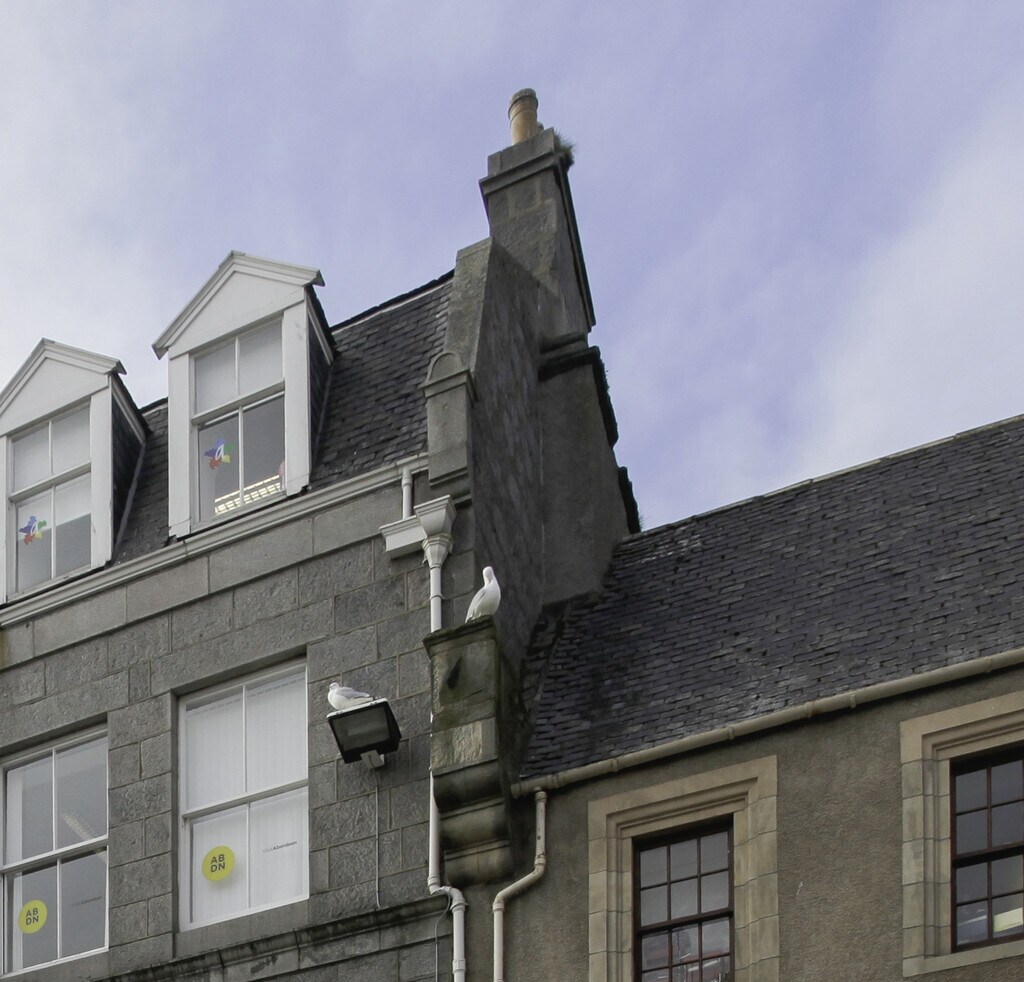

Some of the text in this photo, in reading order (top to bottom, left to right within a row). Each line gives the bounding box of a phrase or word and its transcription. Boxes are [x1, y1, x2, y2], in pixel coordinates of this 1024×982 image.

[210, 853, 225, 865] AB
[210, 862, 226, 873] DN
[25, 907, 38, 917] AB
[25, 915, 39, 925] DN
